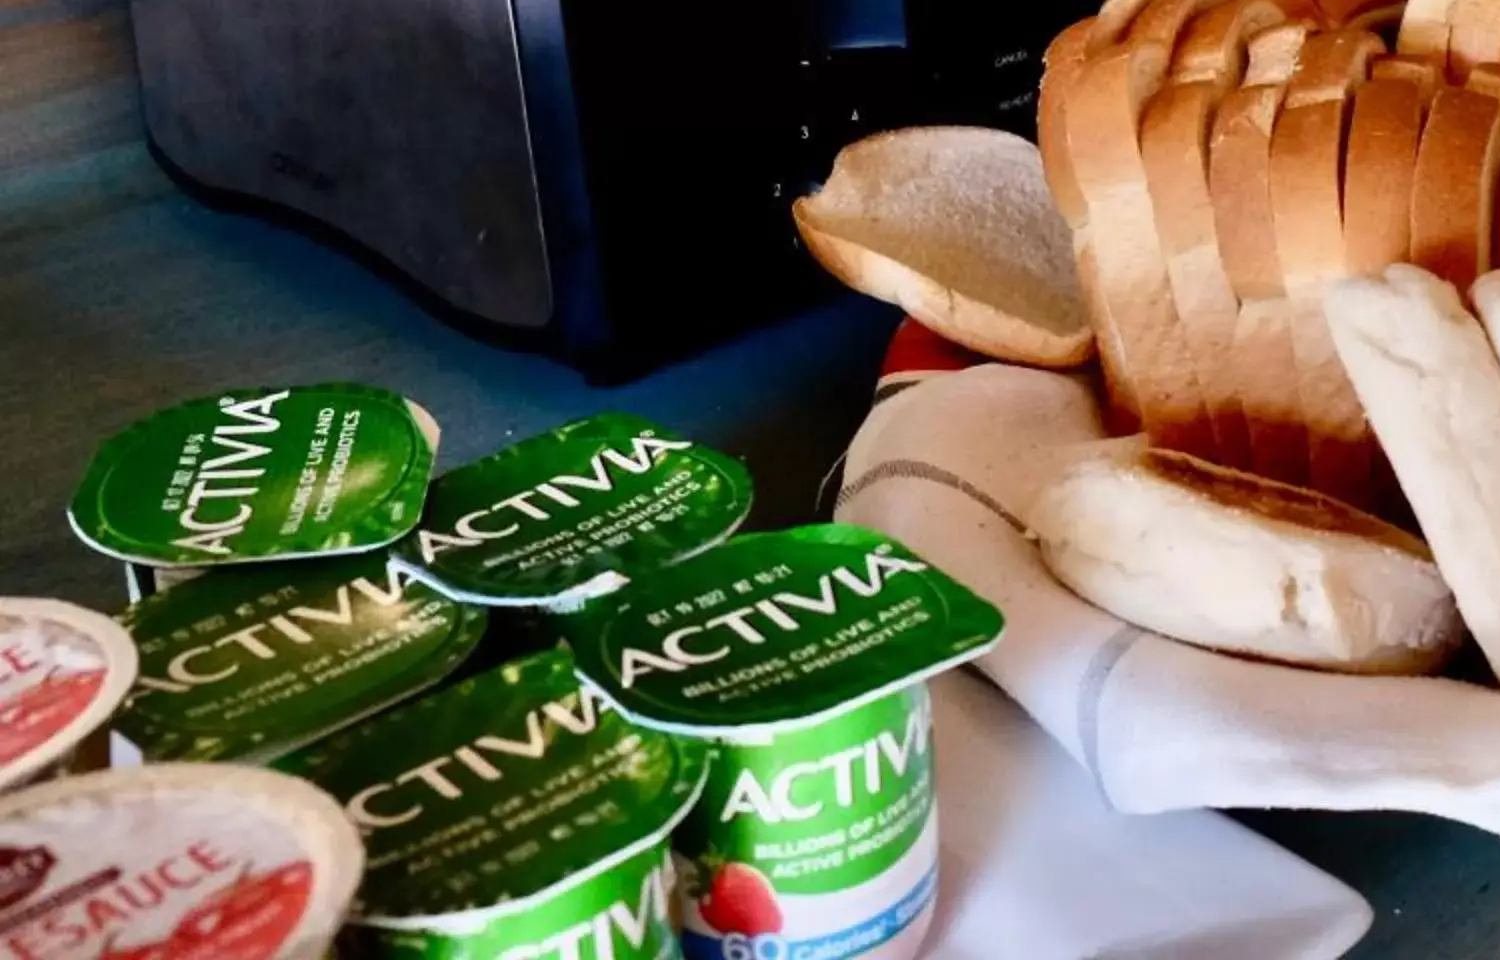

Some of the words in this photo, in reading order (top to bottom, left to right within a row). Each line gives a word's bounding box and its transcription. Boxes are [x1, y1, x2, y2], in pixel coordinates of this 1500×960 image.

[801, 126, 809, 139] 3
[305, 436, 328, 465] LIVE
[314, 408, 335, 436] AND
[170, 390, 290, 554] ACTIVIA
[419, 436, 693, 564] ACTIVIA
[607, 494, 651, 518] LIVE
[654, 471, 693, 495] AND
[590, 481, 701, 541] PROBIOTICS
[620, 550, 928, 689] ACTIVIA
[682, 656, 788, 699] BILLIONS
[789, 642, 820, 663] OF
[825, 618, 874, 648] LIVE
[877, 596, 922, 622] AND
[802, 611, 931, 673] PROBIOTICS
